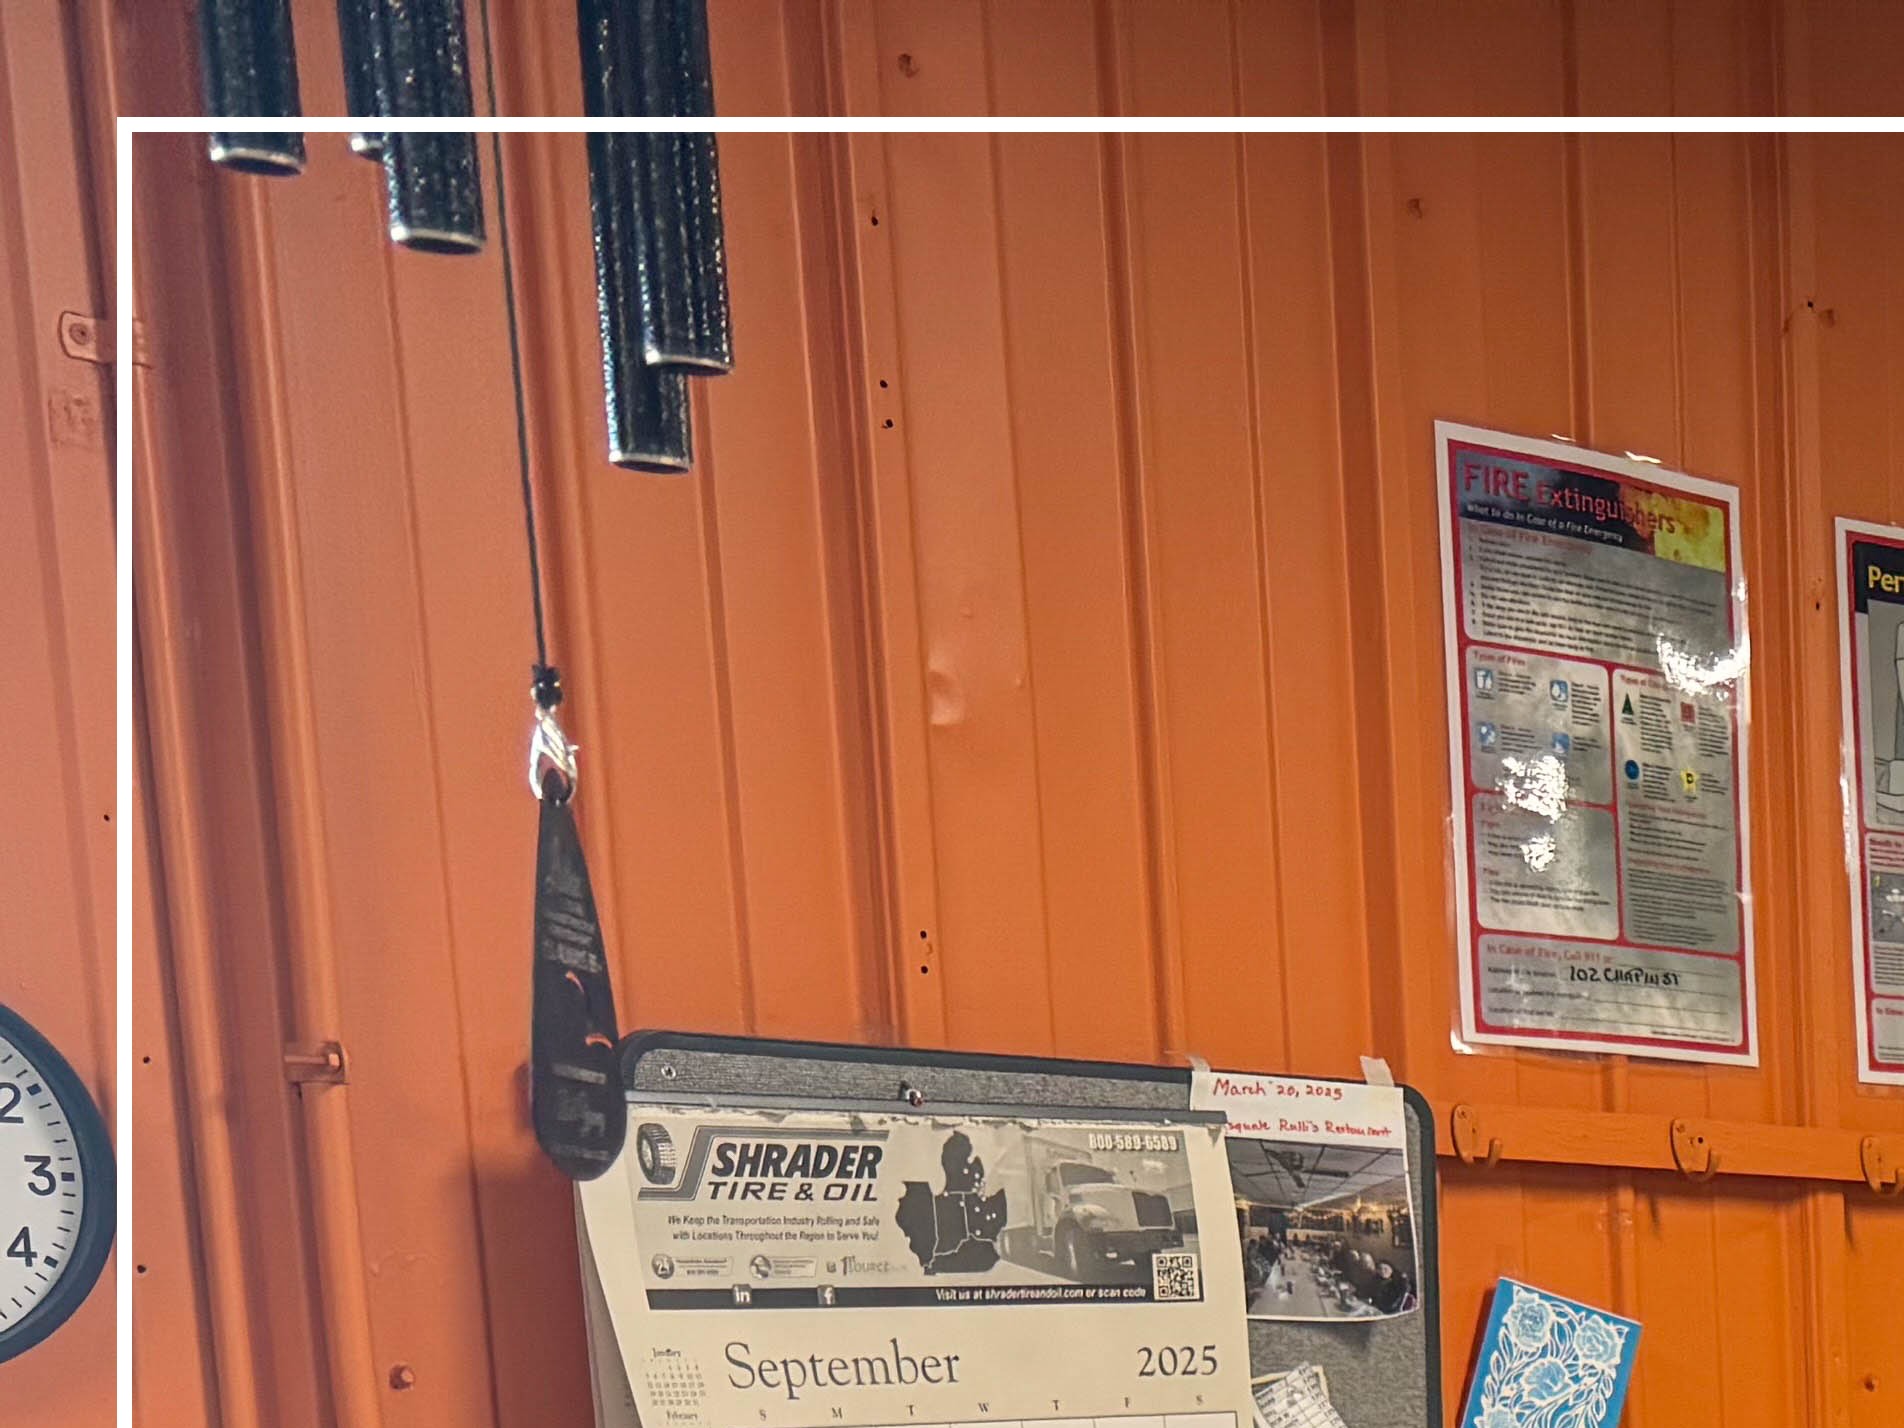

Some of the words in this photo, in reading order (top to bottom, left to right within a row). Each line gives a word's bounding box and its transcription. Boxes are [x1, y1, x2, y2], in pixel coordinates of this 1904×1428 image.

[1463, 463, 1530, 501] FIRE
[1536, 484, 1677, 535] Extinguishers
[1212, 1077, 1266, 1098] March
[1088, 1132, 1178, 1152] 800-589-6589
[711, 1143, 884, 1180] SHRADER
[23, 1155, 57, 1197] 3
[707, 1181, 788, 1201] TIRE
[794, 1183, 815, 1202] &
[823, 1183, 879, 1202] OIL
[683, 1215, 705, 1227] Keep
[706, 1215, 720, 1226] the
[722, 1214, 782, 1228] Transportation
[783, 1215, 815, 1228] Industry
[816, 1215, 844, 1228] Rolling
[845, 1216, 861, 1227] and
[862, 1216, 880, 1227] Safe
[6, 1226, 38, 1268] 4
[673, 1230, 690, 1241] with
[692, 1230, 733, 1242] Locations
[735, 1230, 784, 1243] Throughout
[785, 1230, 797, 1241] the
[836, 1230, 859, 1242] Serve
[936, 1287, 957, 1301] Visit
[958, 1290, 971, 1301] us
[973, 1289, 983, 1300] at
[985, 1286, 1084, 1301] shradertireandoil.com
[1085, 1289, 1096, 1300] or
[1098, 1288, 1122, 1300] scan
[1123, 1287, 1147, 1299] code
[724, 1337, 961, 1401] September
[1137, 1343, 1218, 1377] 2025
[831, 1406, 844, 1420] M
[905, 1405, 917, 1418] T
[977, 1401, 990, 1414] W
[1051, 1399, 1061, 1412] T
